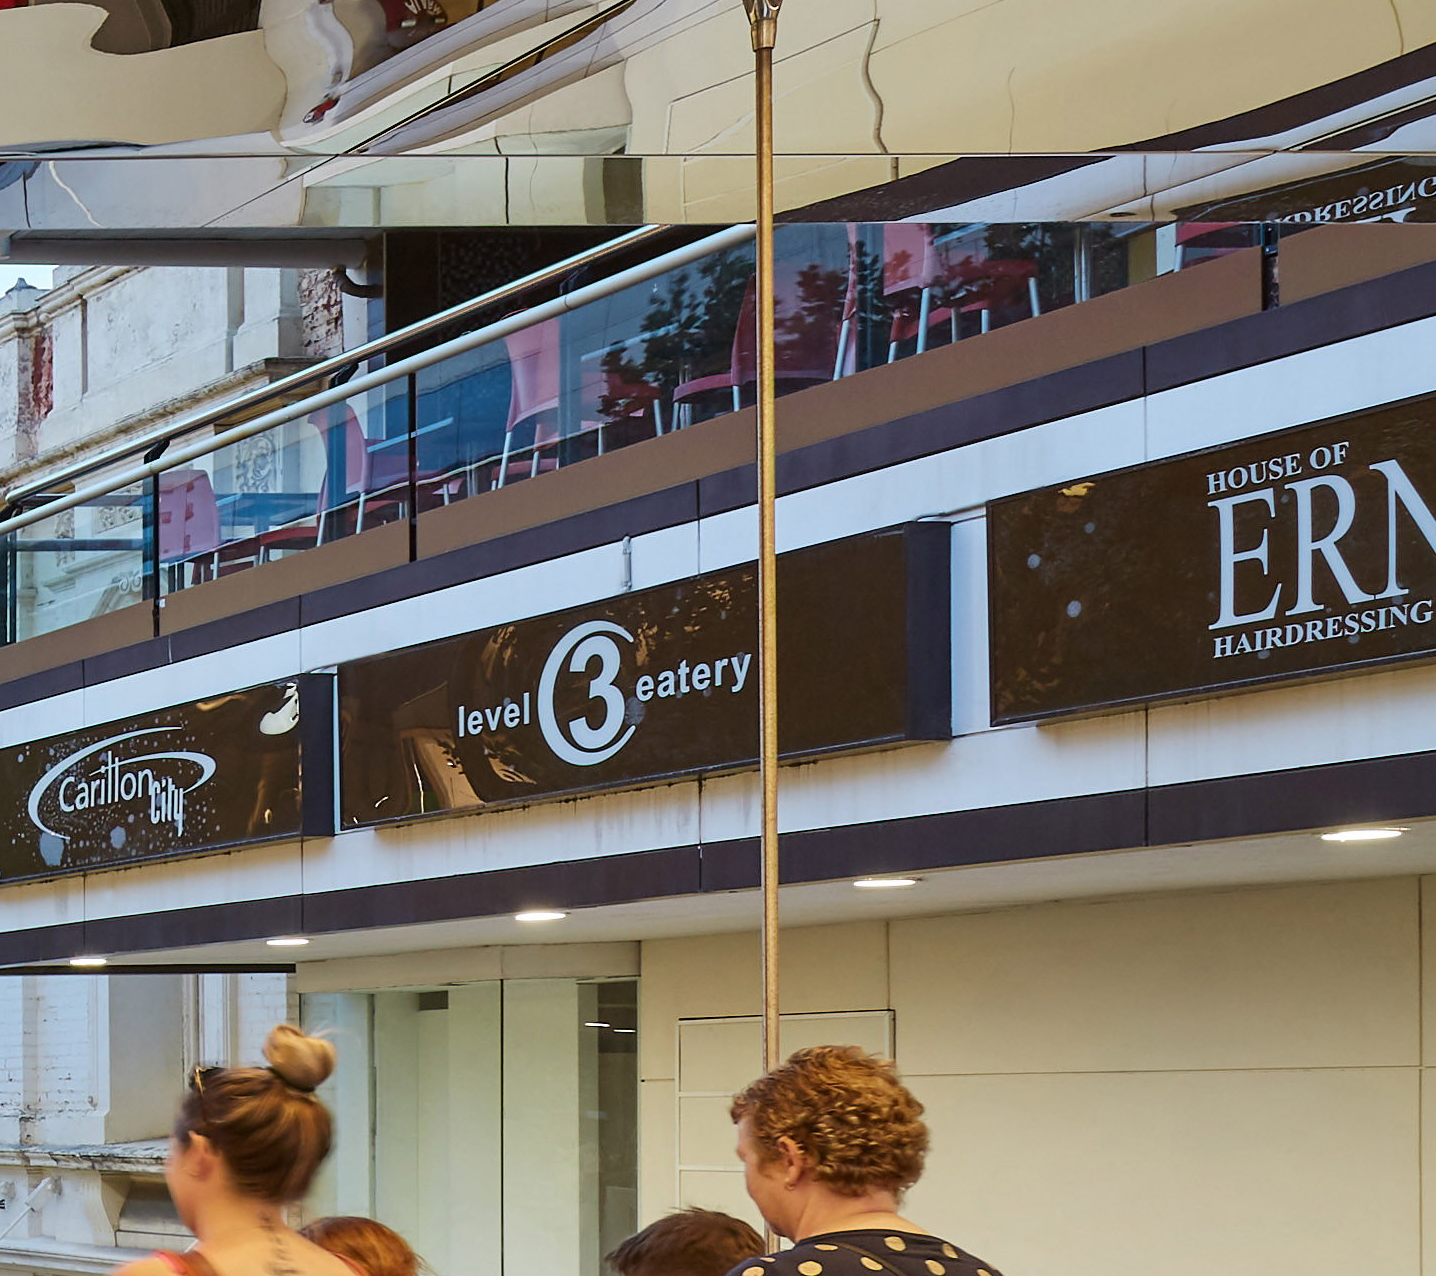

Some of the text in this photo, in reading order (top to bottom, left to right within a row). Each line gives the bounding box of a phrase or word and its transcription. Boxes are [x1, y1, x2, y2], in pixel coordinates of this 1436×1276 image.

[1206, 440, 1350, 496] HOUSE OF
[1212, 598, 1434, 659] HAIRDRESSING
[457, 634, 753, 750] level 3 eatery
